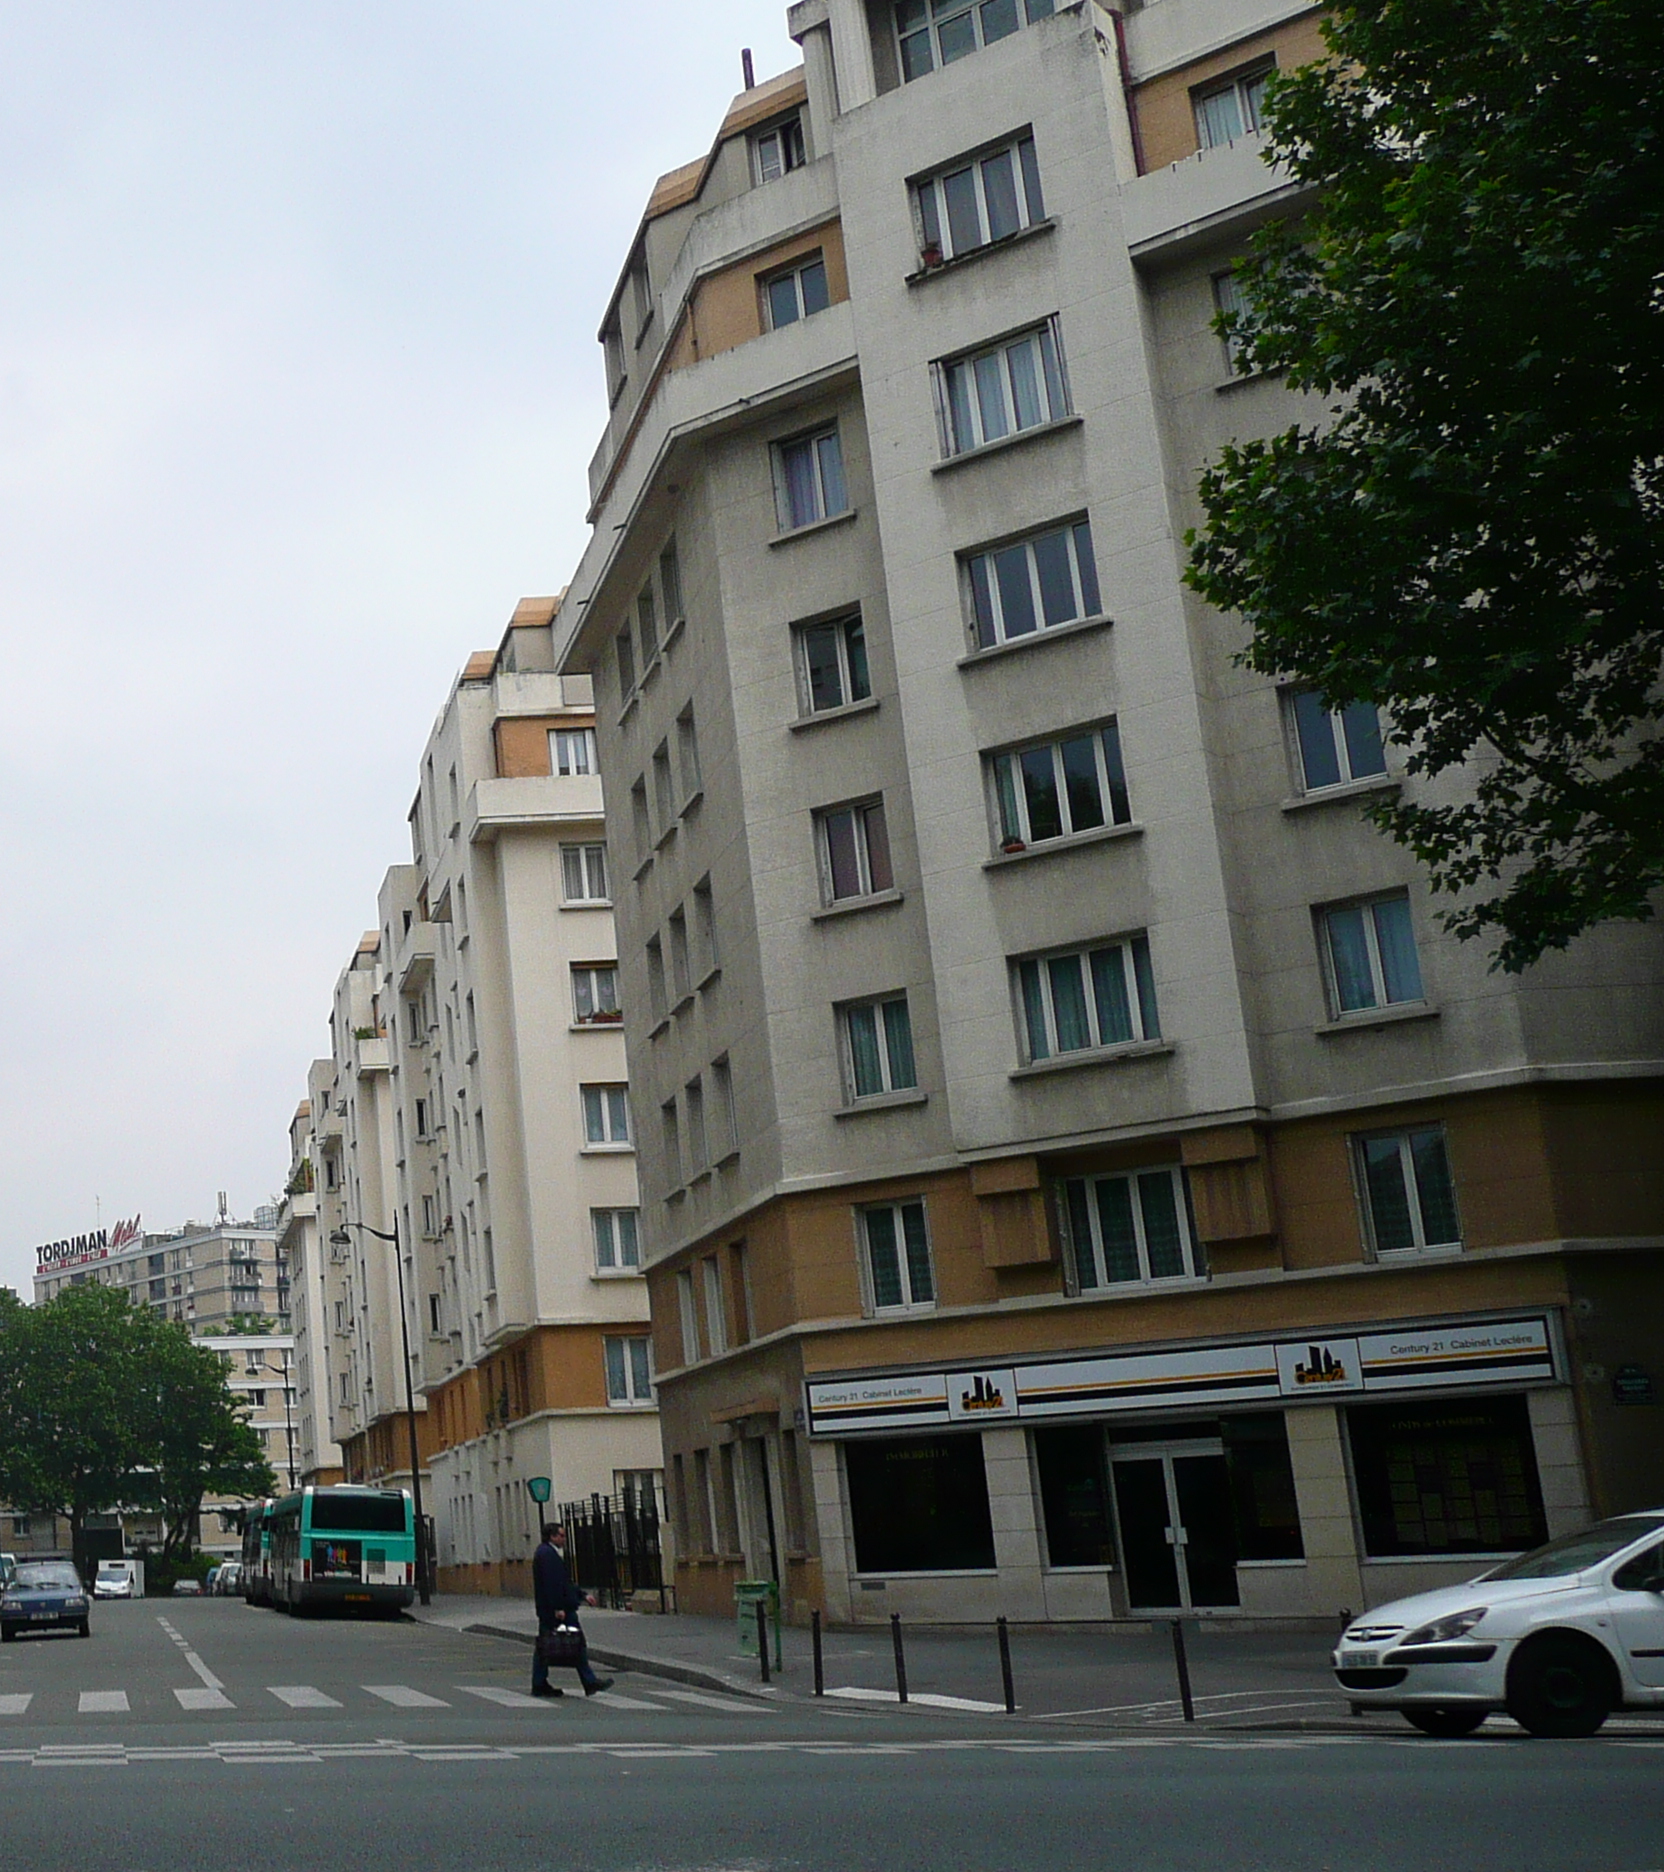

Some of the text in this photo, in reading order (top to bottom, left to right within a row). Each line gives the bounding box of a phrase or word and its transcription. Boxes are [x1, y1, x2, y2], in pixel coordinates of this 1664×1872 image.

[36, 1229, 108, 1265] TORDJMAN
[1390, 1343, 1429, 1354] Century
[1432, 1342, 1444, 1351] 21
[1450, 1338, 1491, 1350] Cabinet
[818, 1394, 848, 1403] Century
[849, 1392, 858, 1401] 21
[862, 1389, 892, 1399] Cabinet
